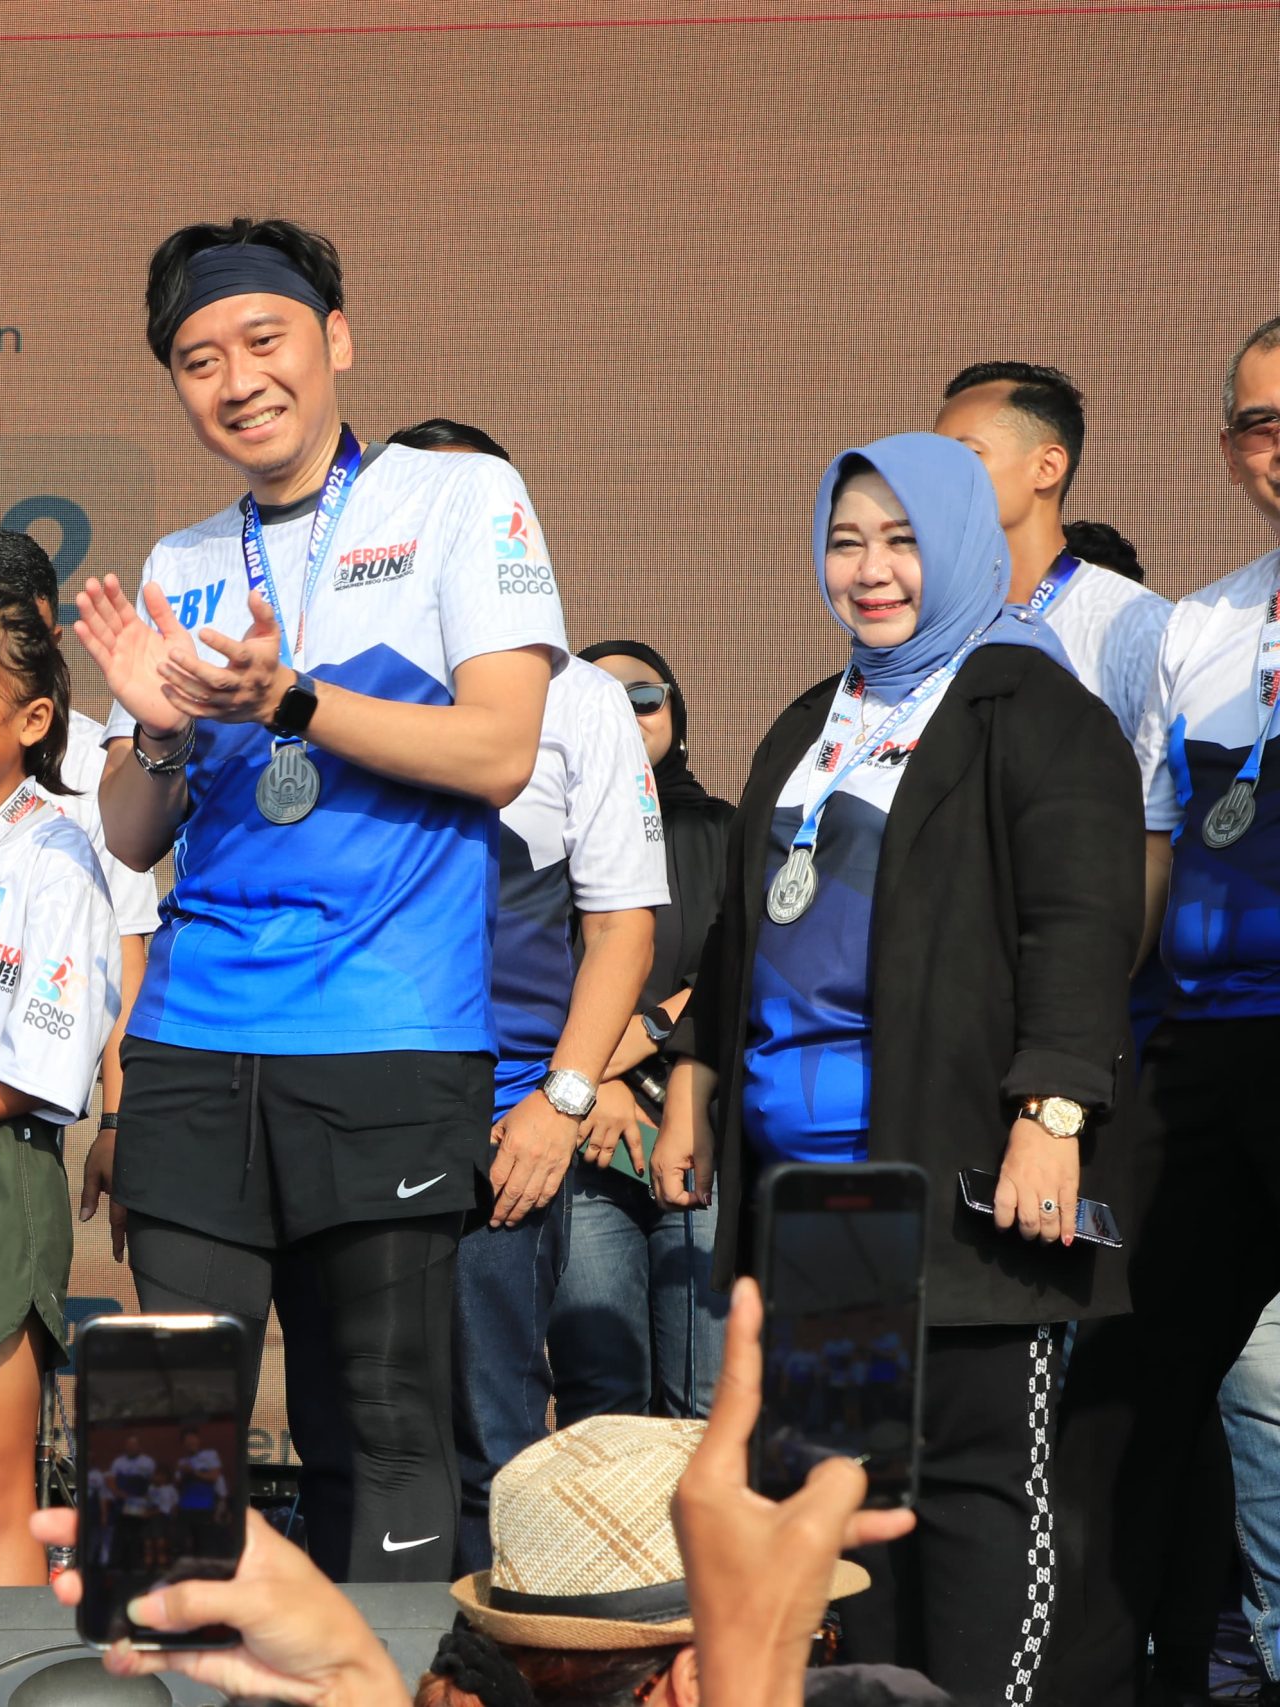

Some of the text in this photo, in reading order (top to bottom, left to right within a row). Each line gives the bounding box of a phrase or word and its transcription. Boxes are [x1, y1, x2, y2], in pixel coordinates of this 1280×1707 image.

[310, 466, 347, 556] RUN 2025
[245, 540, 264, 579] RUN
[339, 539, 417, 565] MERDEKA
[349, 555, 405, 583] RUN
[497, 563, 551, 580] PONO
[498, 579, 554, 595] ROGO
[1030, 580, 1055, 614] 025
[849, 701, 912, 766] MERDEKA
[0, 974, 15, 987] 25
[22, 1010, 71, 1040] ROGO
[27, 997, 75, 1027] PONO
